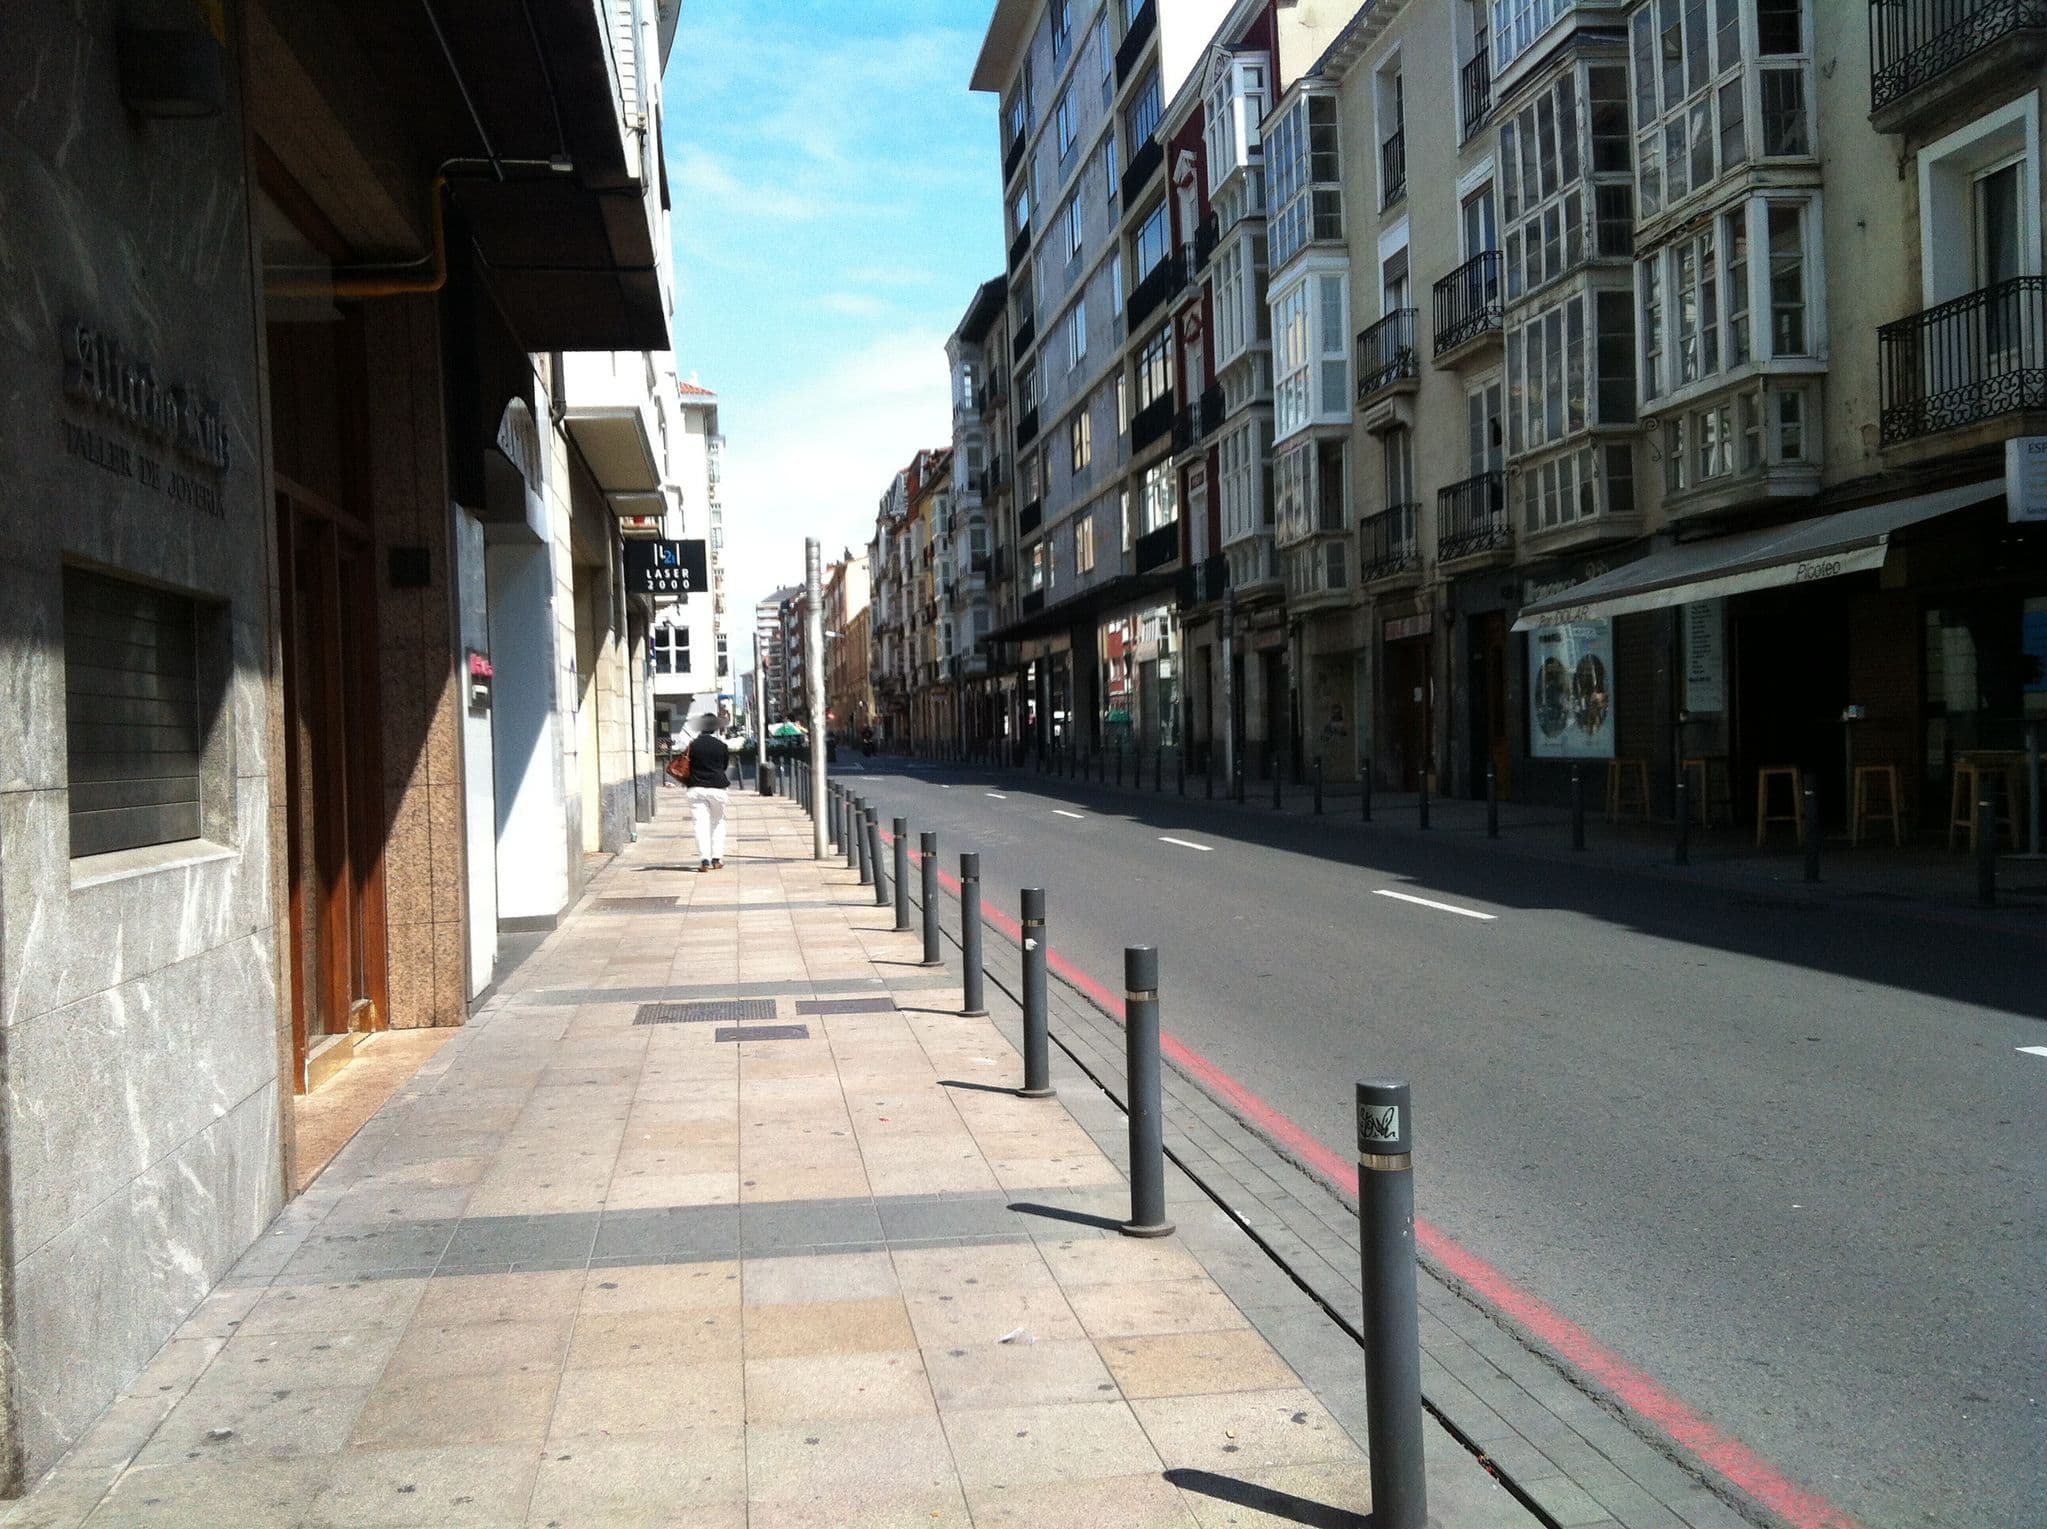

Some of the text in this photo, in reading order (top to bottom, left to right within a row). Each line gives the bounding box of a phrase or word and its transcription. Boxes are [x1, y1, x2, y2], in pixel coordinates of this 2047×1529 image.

[61, 418, 226, 521] TALLER DE JOYERIA
[646, 568, 690, 579] LASER
[1796, 561, 1841, 581] Picoteo
[647, 580, 690, 591] 2000
